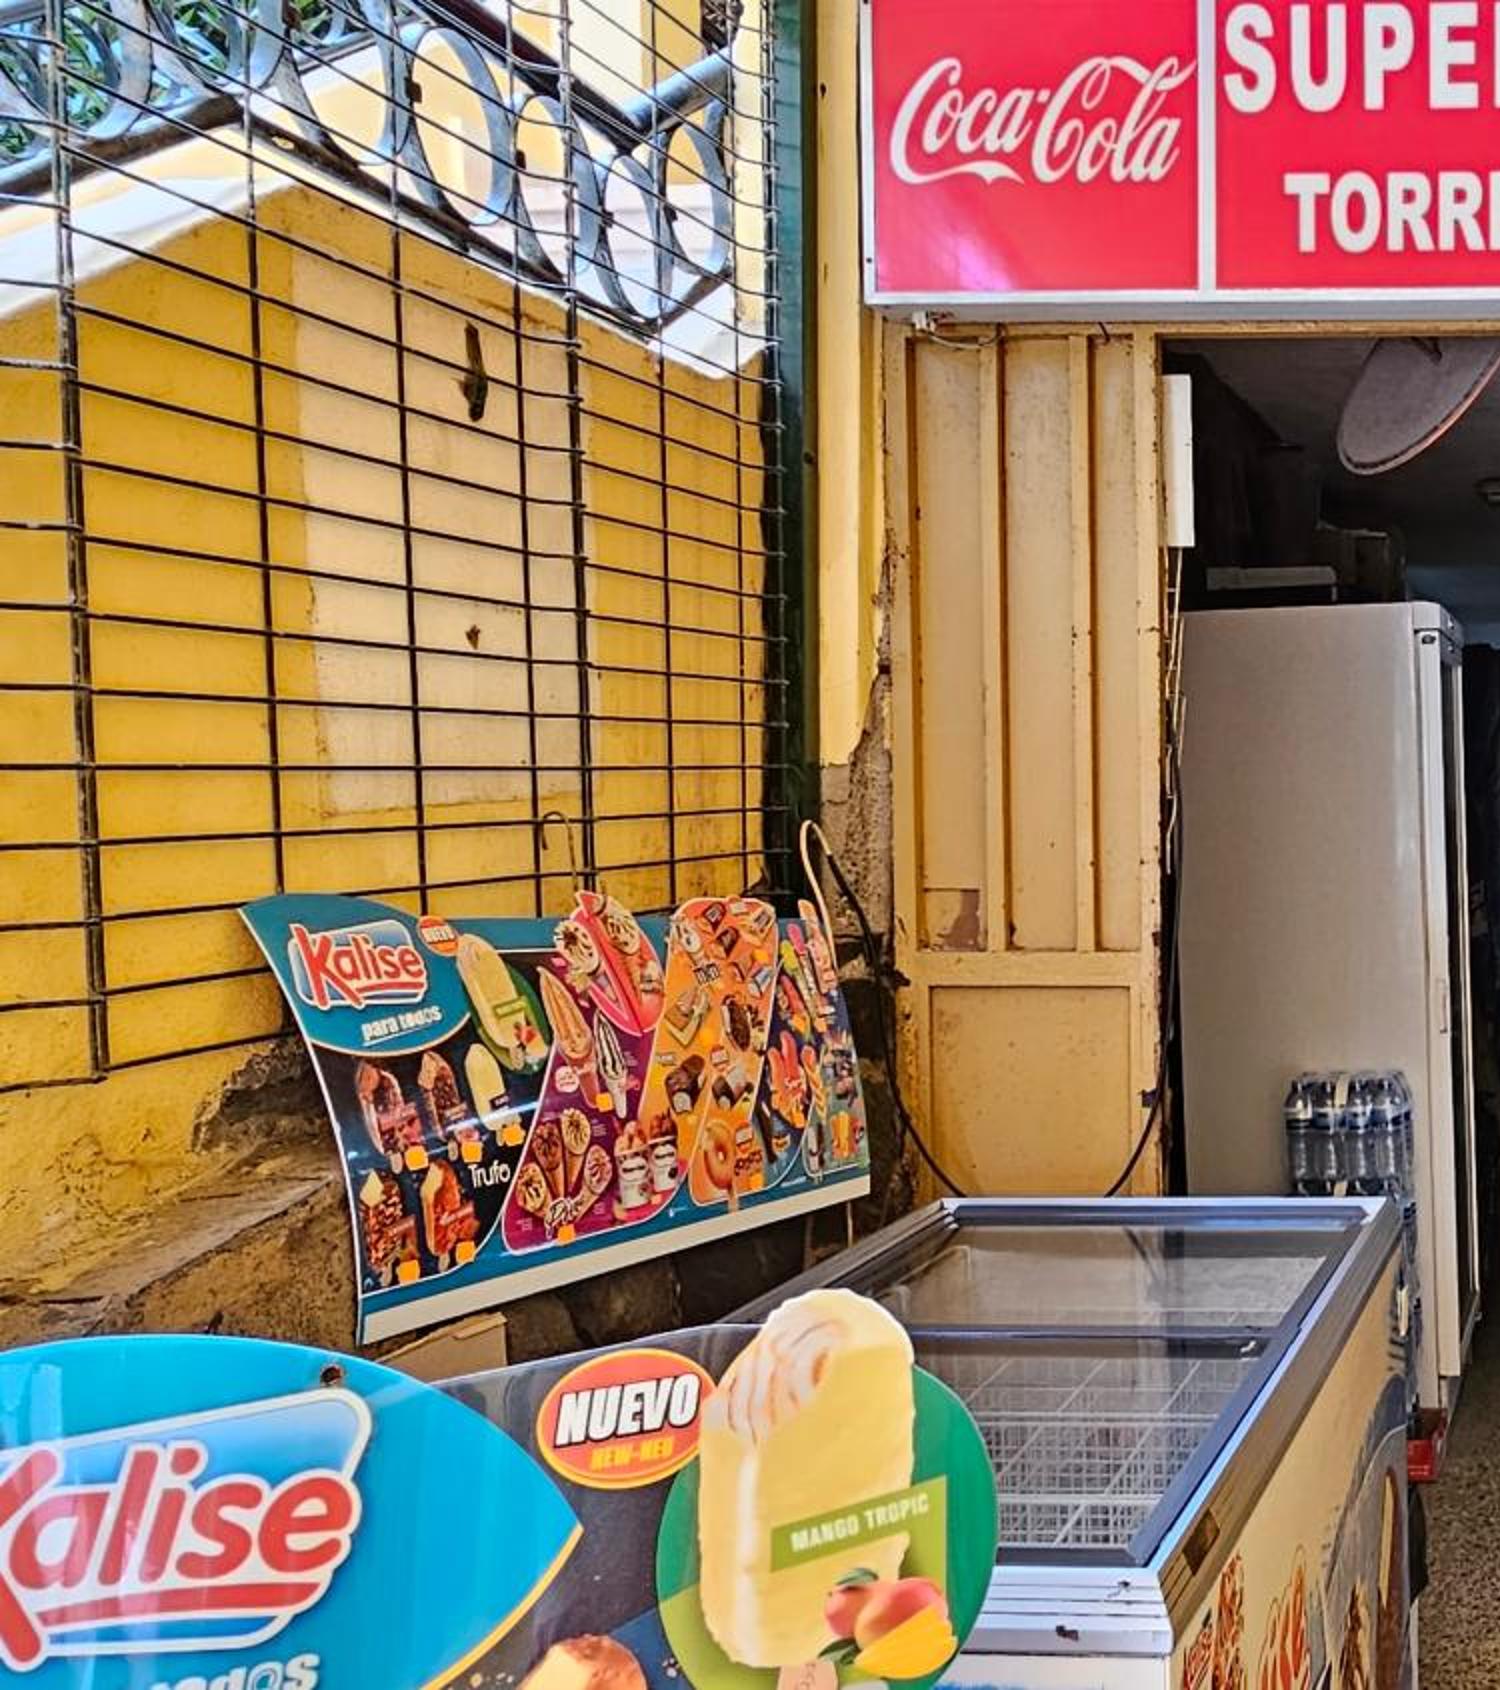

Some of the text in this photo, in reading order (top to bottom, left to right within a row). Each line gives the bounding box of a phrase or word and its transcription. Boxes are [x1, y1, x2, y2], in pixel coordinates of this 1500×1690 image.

[890, 56, 1197, 184] Coca-Cola
[292, 926, 425, 1010] Kalise
[361, 1017, 400, 1042] para
[554, 1373, 701, 1448] NUEVO
[790, 1492, 929, 1552] MANGO TROPIC
